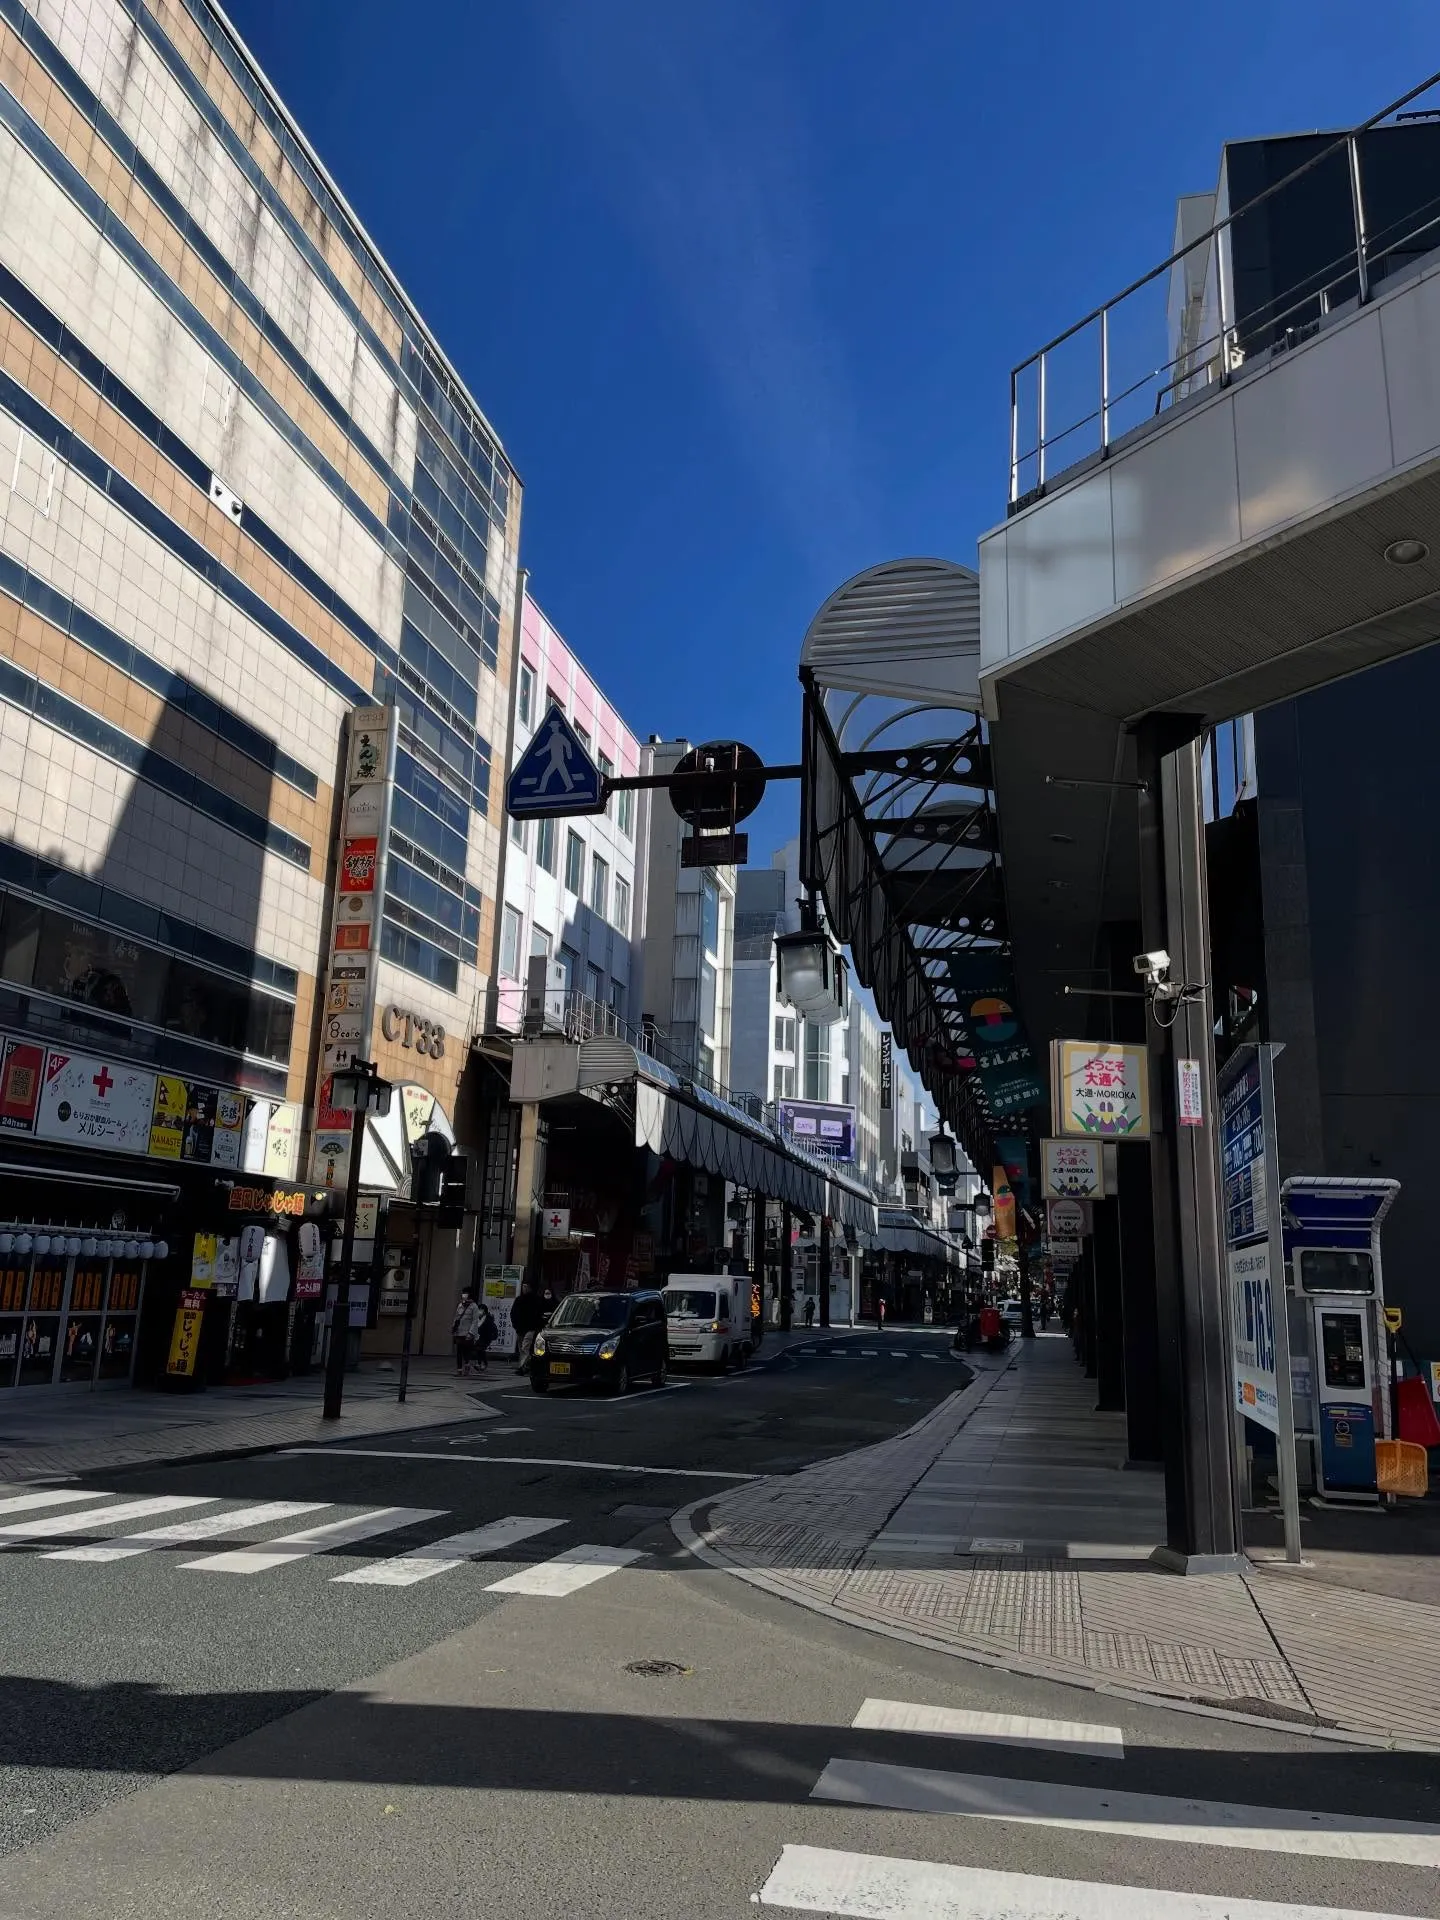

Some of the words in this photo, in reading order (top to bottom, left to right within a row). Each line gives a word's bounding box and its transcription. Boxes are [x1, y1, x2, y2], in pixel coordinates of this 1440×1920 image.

[380, 1003, 446, 1060] CT33
[49, 1056, 64, 1071] 4F
[882, 1034, 891, 1089] レインボービル
[1084, 1057, 1127, 1073] ようこそ
[1084, 1072, 1127, 1087] 大通へ
[73, 1112, 122, 1128] もりおか献血ルーム
[77, 1122, 115, 1137] メルシー
[151, 1133, 181, 1148] NAMASTE
[1056, 1147, 1088, 1157] ようこそ
[1057, 1156, 1088, 1166] 大通へ
